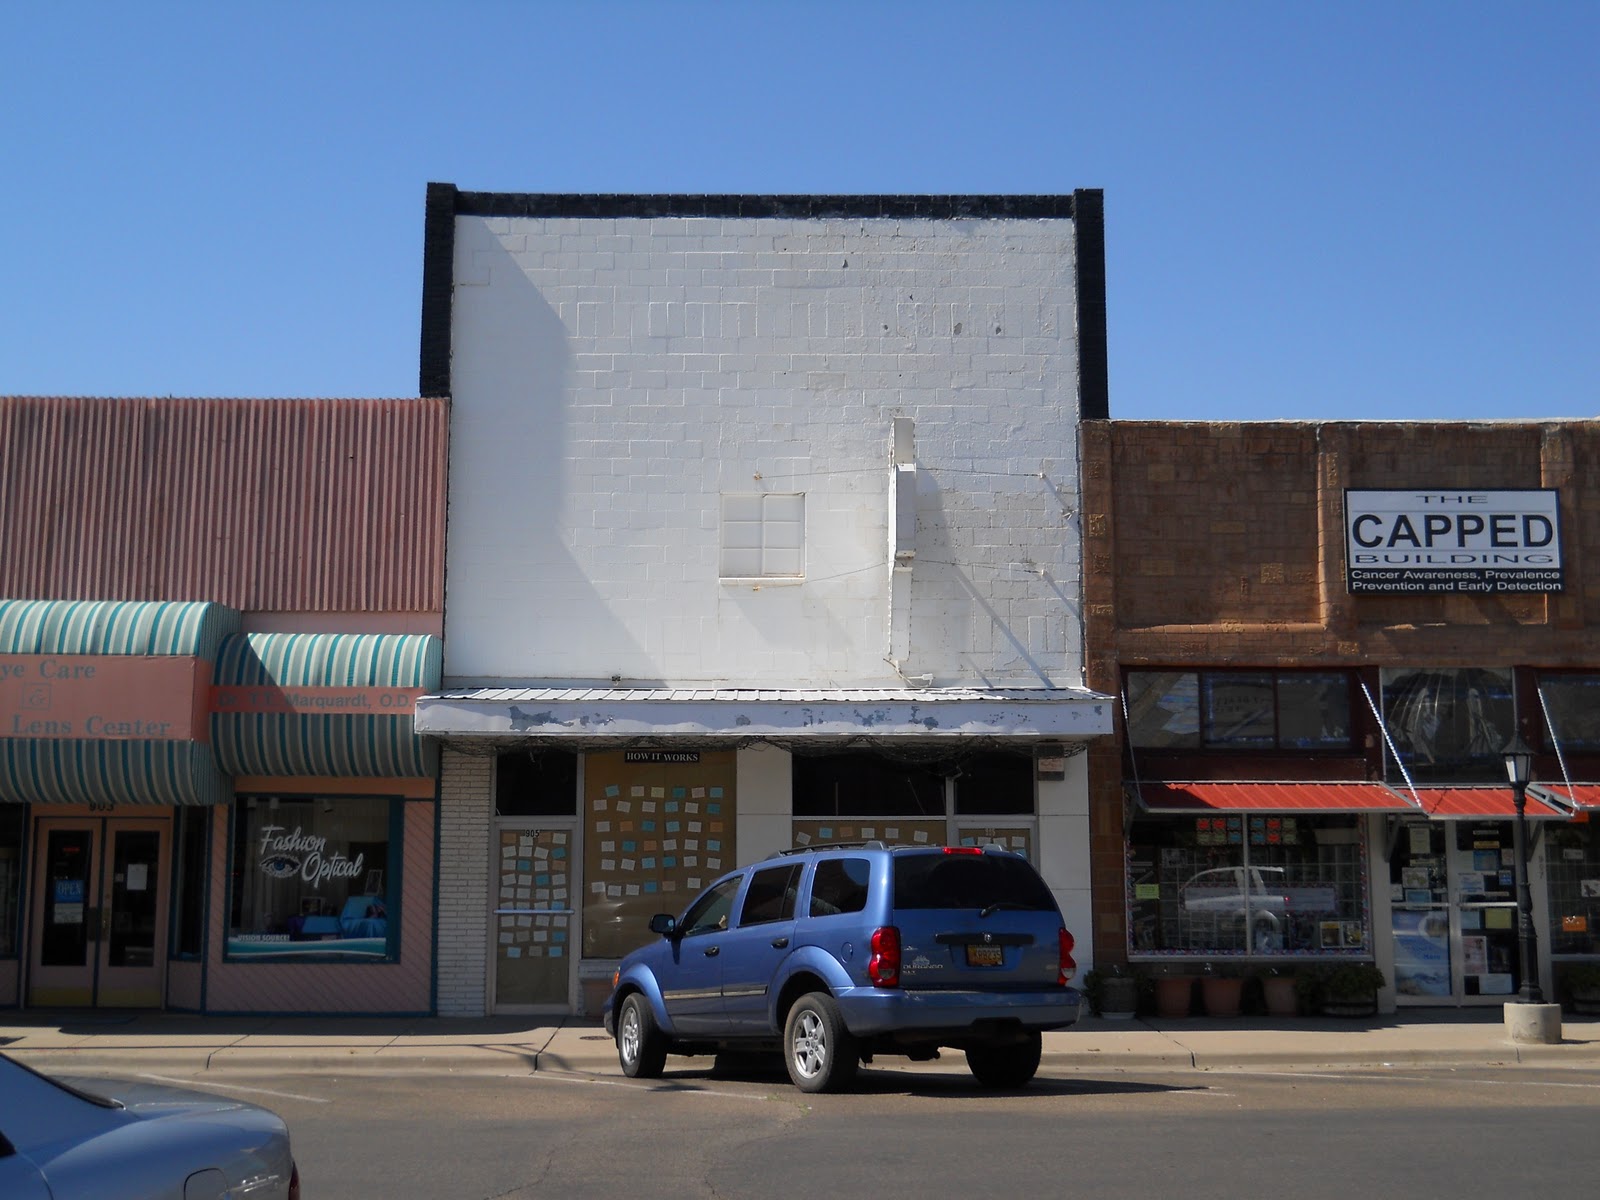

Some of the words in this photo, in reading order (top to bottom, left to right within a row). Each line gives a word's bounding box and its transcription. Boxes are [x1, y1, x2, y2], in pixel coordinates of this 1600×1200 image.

[1416, 495, 1488, 504] THE
[1352, 513, 1553, 548] CAPPED
[1355, 554, 1553, 564] BUILDING
[1351, 570, 1399, 580] Cancer
[1403, 570, 1480, 580] Awareness,
[1485, 570, 1560, 580] Prevalence
[1352, 581, 1425, 591] Prevention
[1428, 581, 1454, 591] and
[1458, 581, 1493, 592] Early
[1496, 581, 1562, 591] Detection
[40, 659, 96, 679] Care
[379, 694, 412, 707] O.D.
[12, 714, 72, 735] Lens
[85, 716, 171, 736] Center
[626, 752, 650, 761] HOW
[651, 752, 662, 761] IT
[663, 753, 699, 762] WORKS
[260, 824, 326, 855] Fashion
[525, 829, 540, 838] 905
[301, 851, 364, 889] Optical
[57, 882, 81, 895] OPEN
